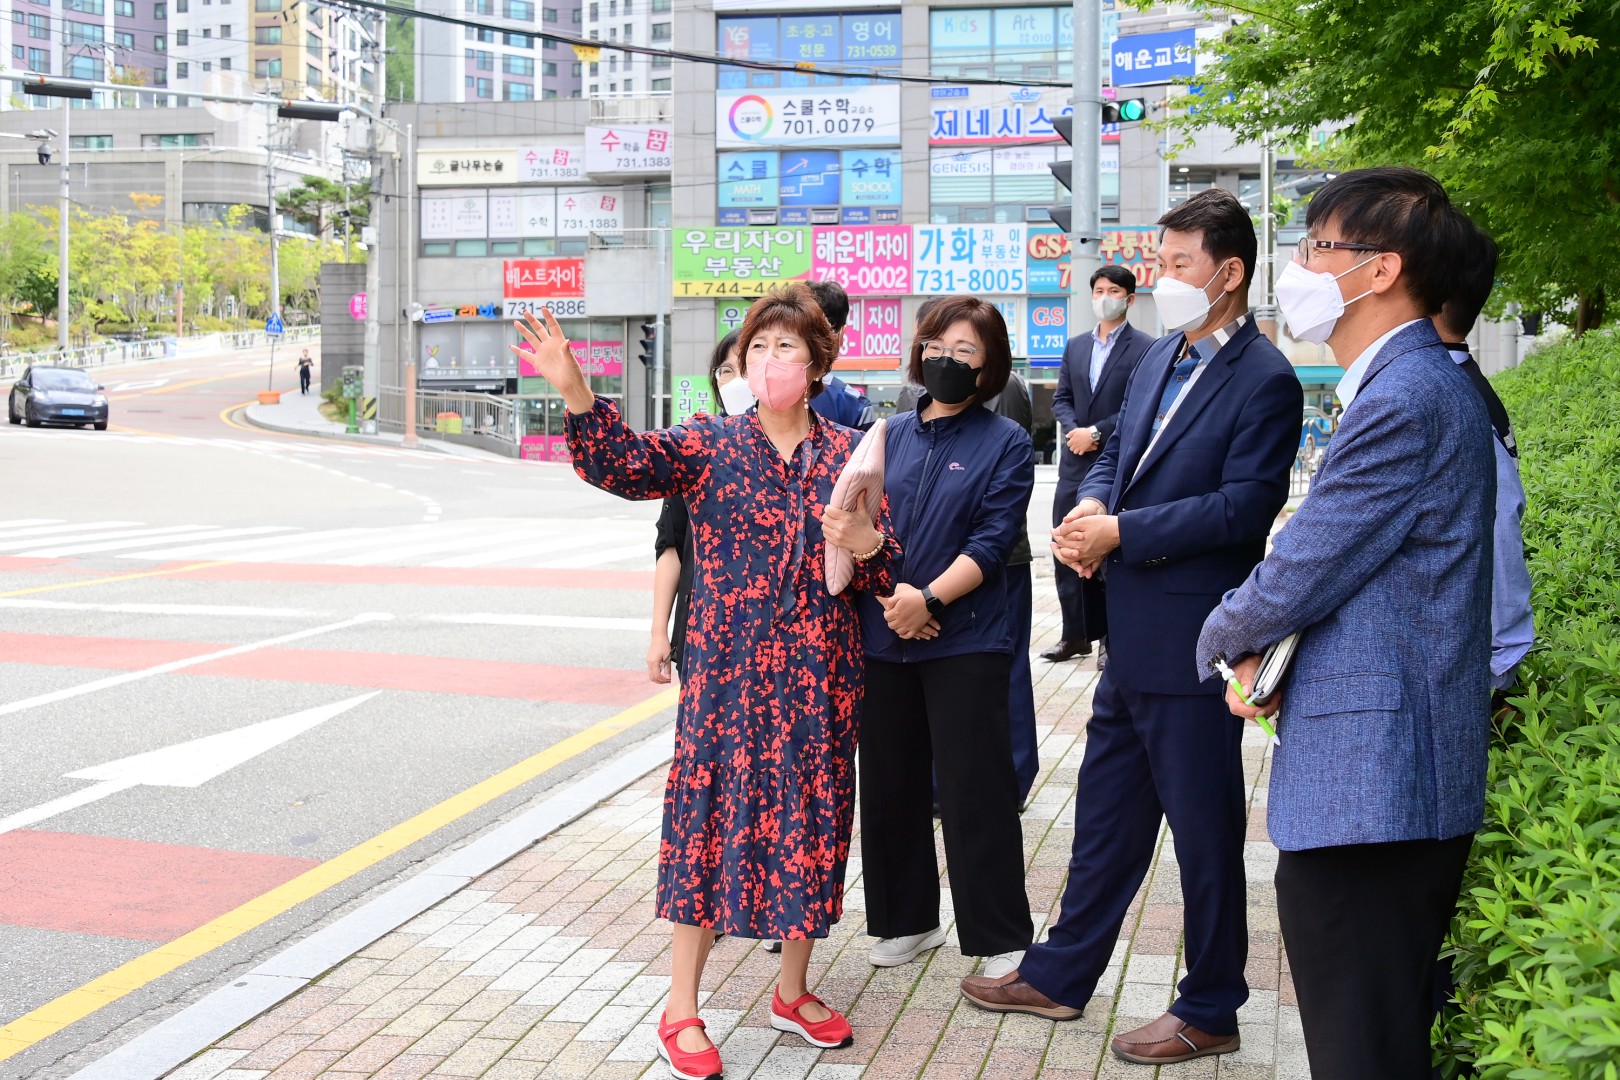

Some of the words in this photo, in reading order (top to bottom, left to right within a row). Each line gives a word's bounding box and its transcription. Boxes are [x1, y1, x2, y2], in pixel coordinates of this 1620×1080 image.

[1012, 14, 1036, 31] Art
[852, 21, 892, 41] 영어
[799, 43, 826, 58] 전문
[847, 44, 897, 58] 731-0539
[1114, 44, 1192, 71] 해운교회
[783, 98, 850, 116] 스쿨수학
[851, 105, 874, 115] 교습소
[783, 118, 875, 134] 701.0079
[450, 159, 504, 172] 글나무논술
[616, 157, 672, 168] 731.1383
[728, 160, 768, 180] 스쿨
[851, 158, 892, 178] 수학
[932, 162, 990, 174] GENESIS
[531, 168, 580, 178] 731.1383
[733, 184, 761, 195] MATH
[851, 182, 893, 193] SCHOOL
[529, 217, 548, 228] 수학
[563, 219, 618, 229] 731.1383
[681, 229, 804, 254] 우리자이
[815, 230, 908, 264] 해운대자이
[918, 227, 977, 265] 가화
[981, 244, 1021, 259] 부동산
[703, 256, 783, 279] 부동산
[505, 266, 576, 289] 베스트자이
[815, 266, 908, 289] 743-0002
[916, 269, 1023, 291] 731-8005
[681, 281, 800, 295] T.744-44
[508, 301, 586, 316] 731-6886
[1033, 307, 1065, 326] GS
[592, 347, 624, 363] 부동산
